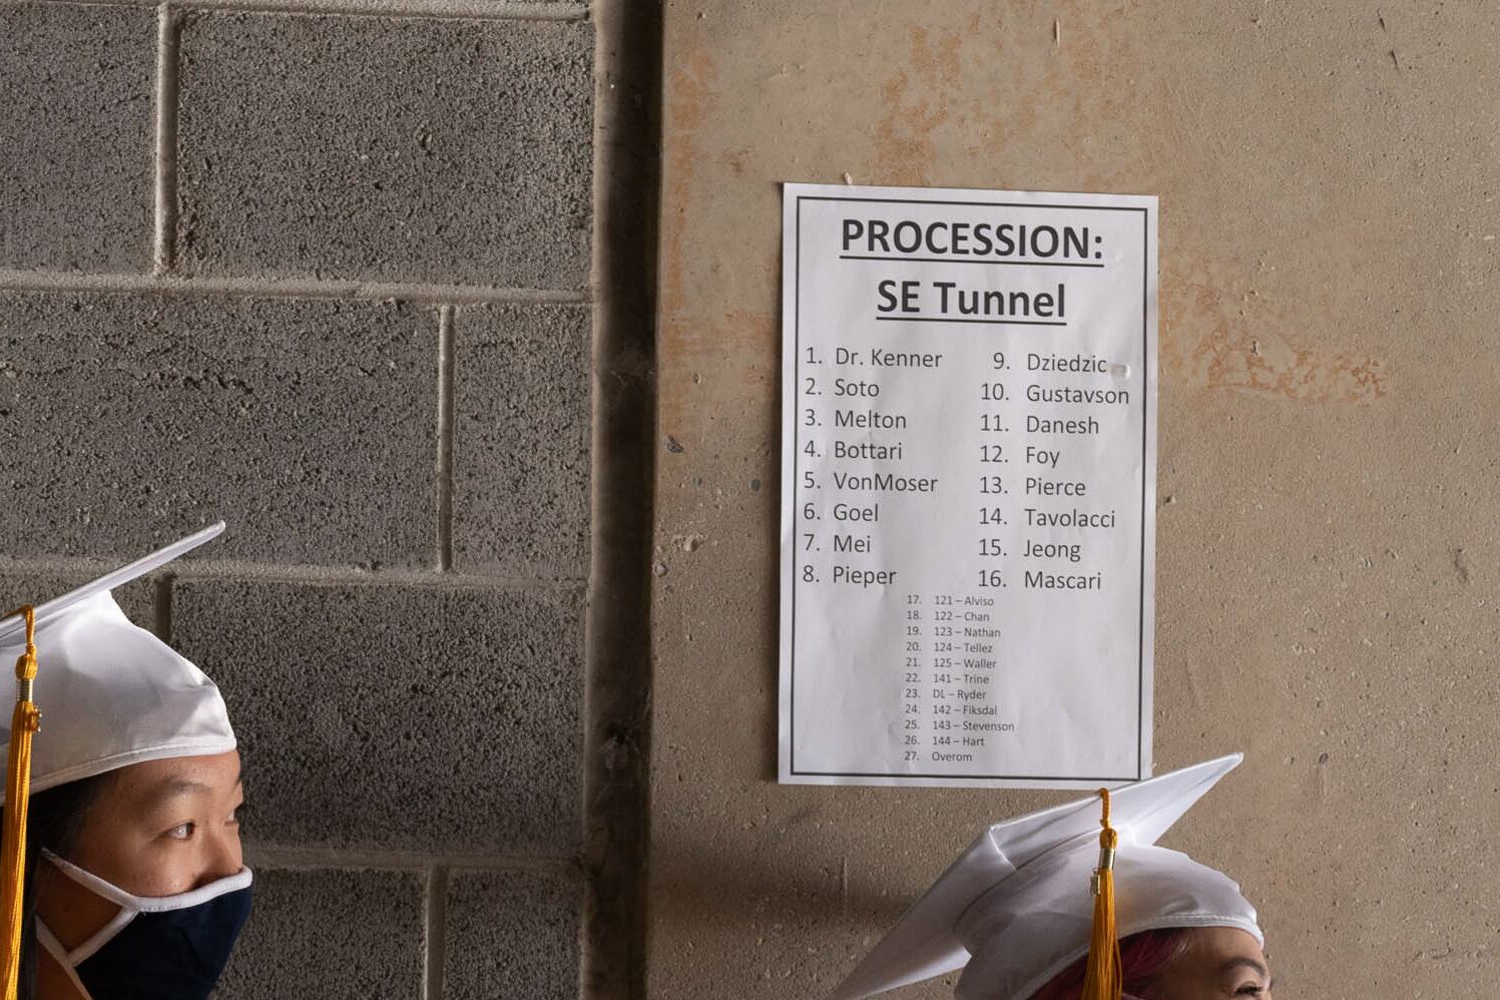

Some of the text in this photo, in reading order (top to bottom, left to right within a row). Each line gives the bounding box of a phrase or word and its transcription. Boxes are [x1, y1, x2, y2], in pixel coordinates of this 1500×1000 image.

[841, 218, 1103, 260] PROCESSION:
[878, 280, 1064, 317] SE Tunnel
[806, 347, 943, 367] 1. Dr. Kenner
[993, 352, 1108, 373] 9. Dziedzic
[805, 378, 879, 397] 2. Soto
[981, 383, 1129, 404] 10. Gustavson
[805, 409, 906, 429] 3. Melton
[981, 414, 1099, 434] 11. Danesh
[804, 440, 902, 460] 4. Bottari
[980, 445, 1060, 469] 12. Foy
[804, 472, 938, 492] 5. VonMoser
[980, 476, 1086, 496] 13. Pierce
[804, 502, 878, 521] 6. Goel
[980, 508, 1115, 528] 14. Tavolacci
[804, 534, 870, 553] 7. Mei
[979, 539, 1081, 562] 15. Jeong
[803, 565, 897, 588] 8. Pieper
[979, 570, 1101, 590] 16. Mascari
[907, 594, 922, 604] 17.
[934, 594, 952, 605] 121
[963, 595, 994, 606] Alviso
[907, 609, 922, 620] 18.
[934, 610, 952, 621] 122
[963, 611, 989, 622] Chan
[906, 625, 921, 635] 19.
[934, 626, 952, 636] 123
[963, 626, 1001, 637] Nathan
[906, 640, 921, 651] 20.
[934, 641, 952, 652] 124
[963, 642, 992, 653] Tellez
[906, 656, 921, 667] 21.
[933, 657, 952, 668] 125
[963, 657, 997, 669] Waller
[905, 672, 921, 682] 22.
[933, 673, 951, 683] 141
[963, 673, 989, 684] Trine
[905, 687, 920, 698] 23.
[932, 688, 945, 699] DL
[957, 688, 987, 702] Ryder
[904, 703, 920, 714] 24.
[933, 704, 951, 714] 142
[962, 703, 997, 715] Fiksdal
[904, 719, 920, 729] 25.
[933, 719, 951, 730] 143
[962, 720, 1014, 731] Stevenson
[904, 734, 920, 745] 26.
[932, 735, 951, 746] 144
[962, 736, 984, 746] Hart
[904, 750, 972, 761] 27. Overom
